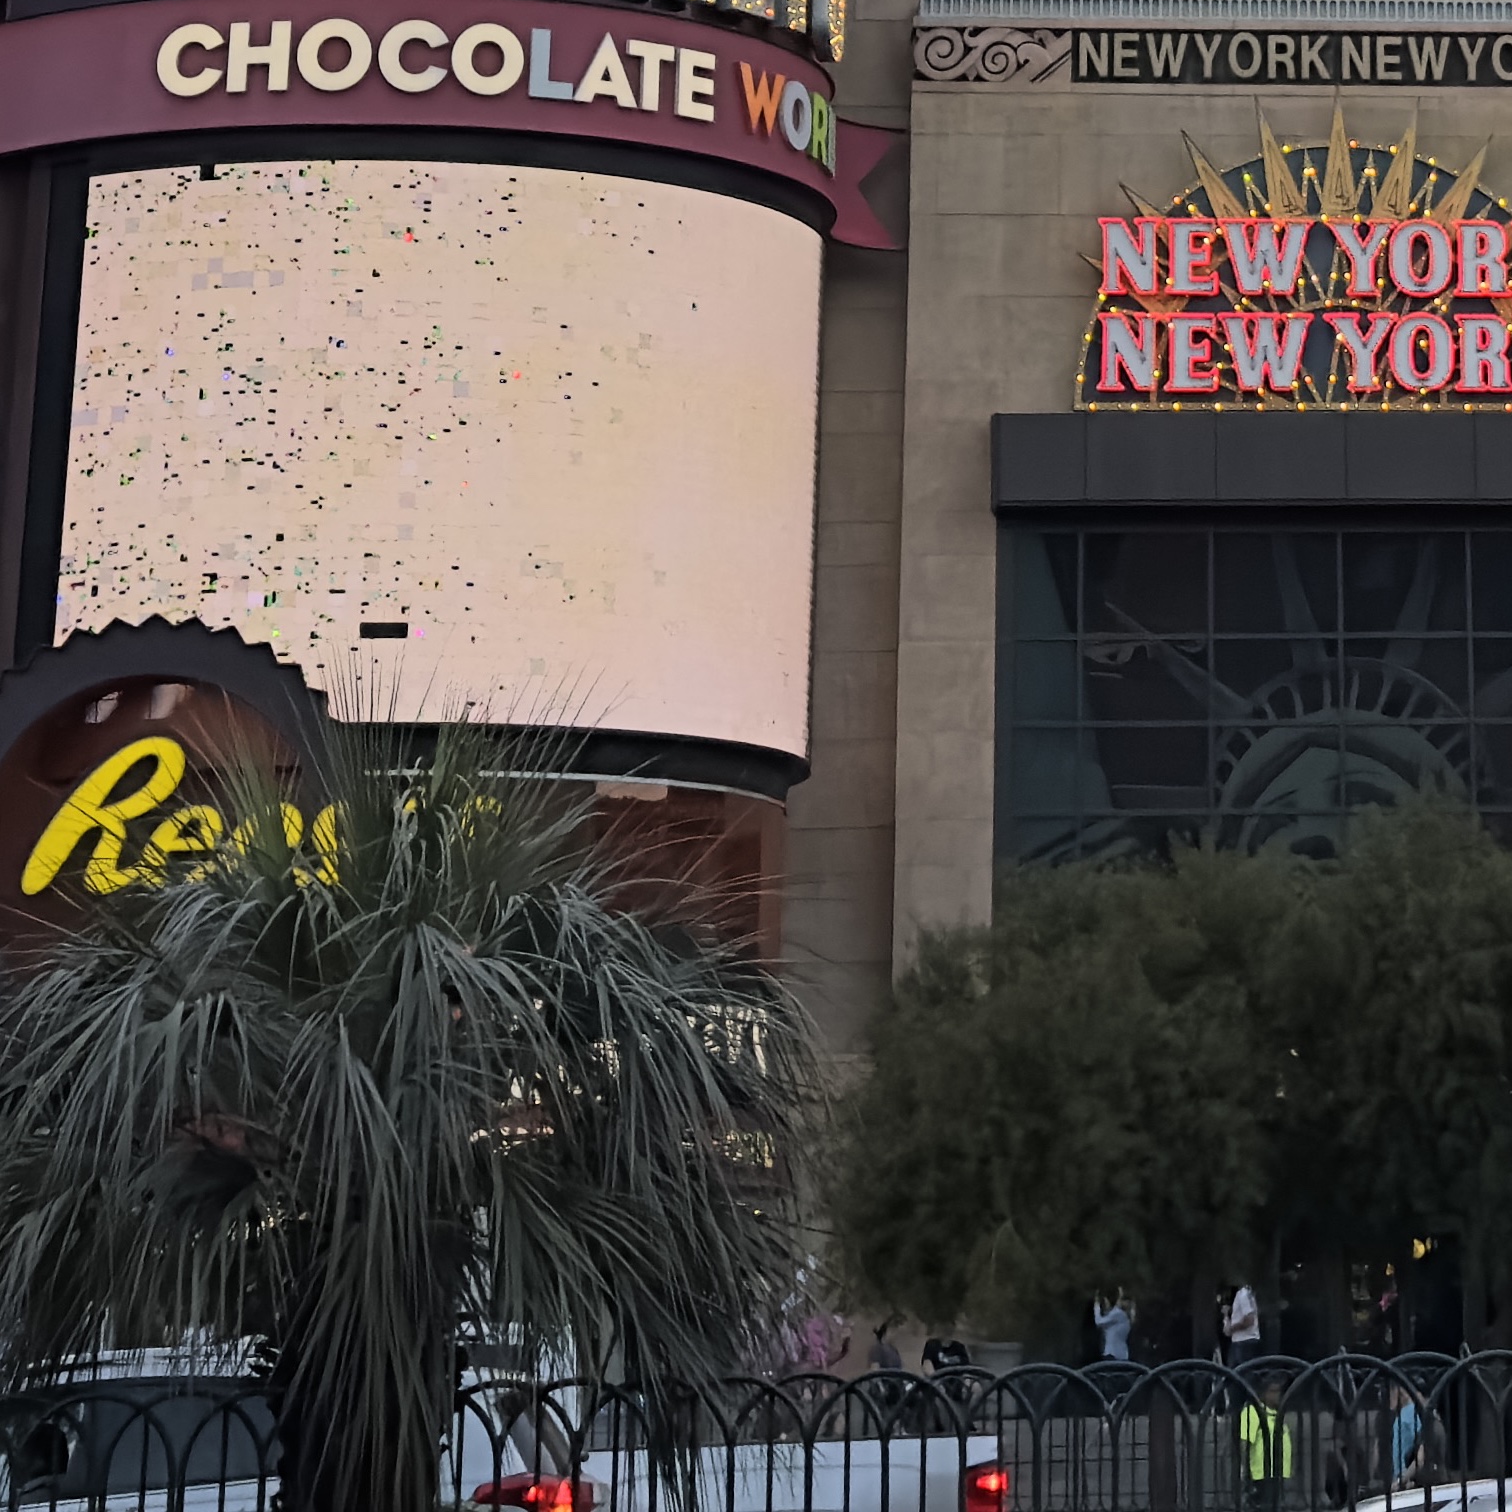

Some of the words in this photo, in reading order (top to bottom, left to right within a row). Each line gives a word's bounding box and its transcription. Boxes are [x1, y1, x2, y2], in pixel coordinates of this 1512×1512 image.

[156, 18, 716, 123] CHOCOLATE
[740, 60, 837, 179] WOR
[1097, 217, 1315, 297] NEW
[1096, 312, 1314, 393] NEW
